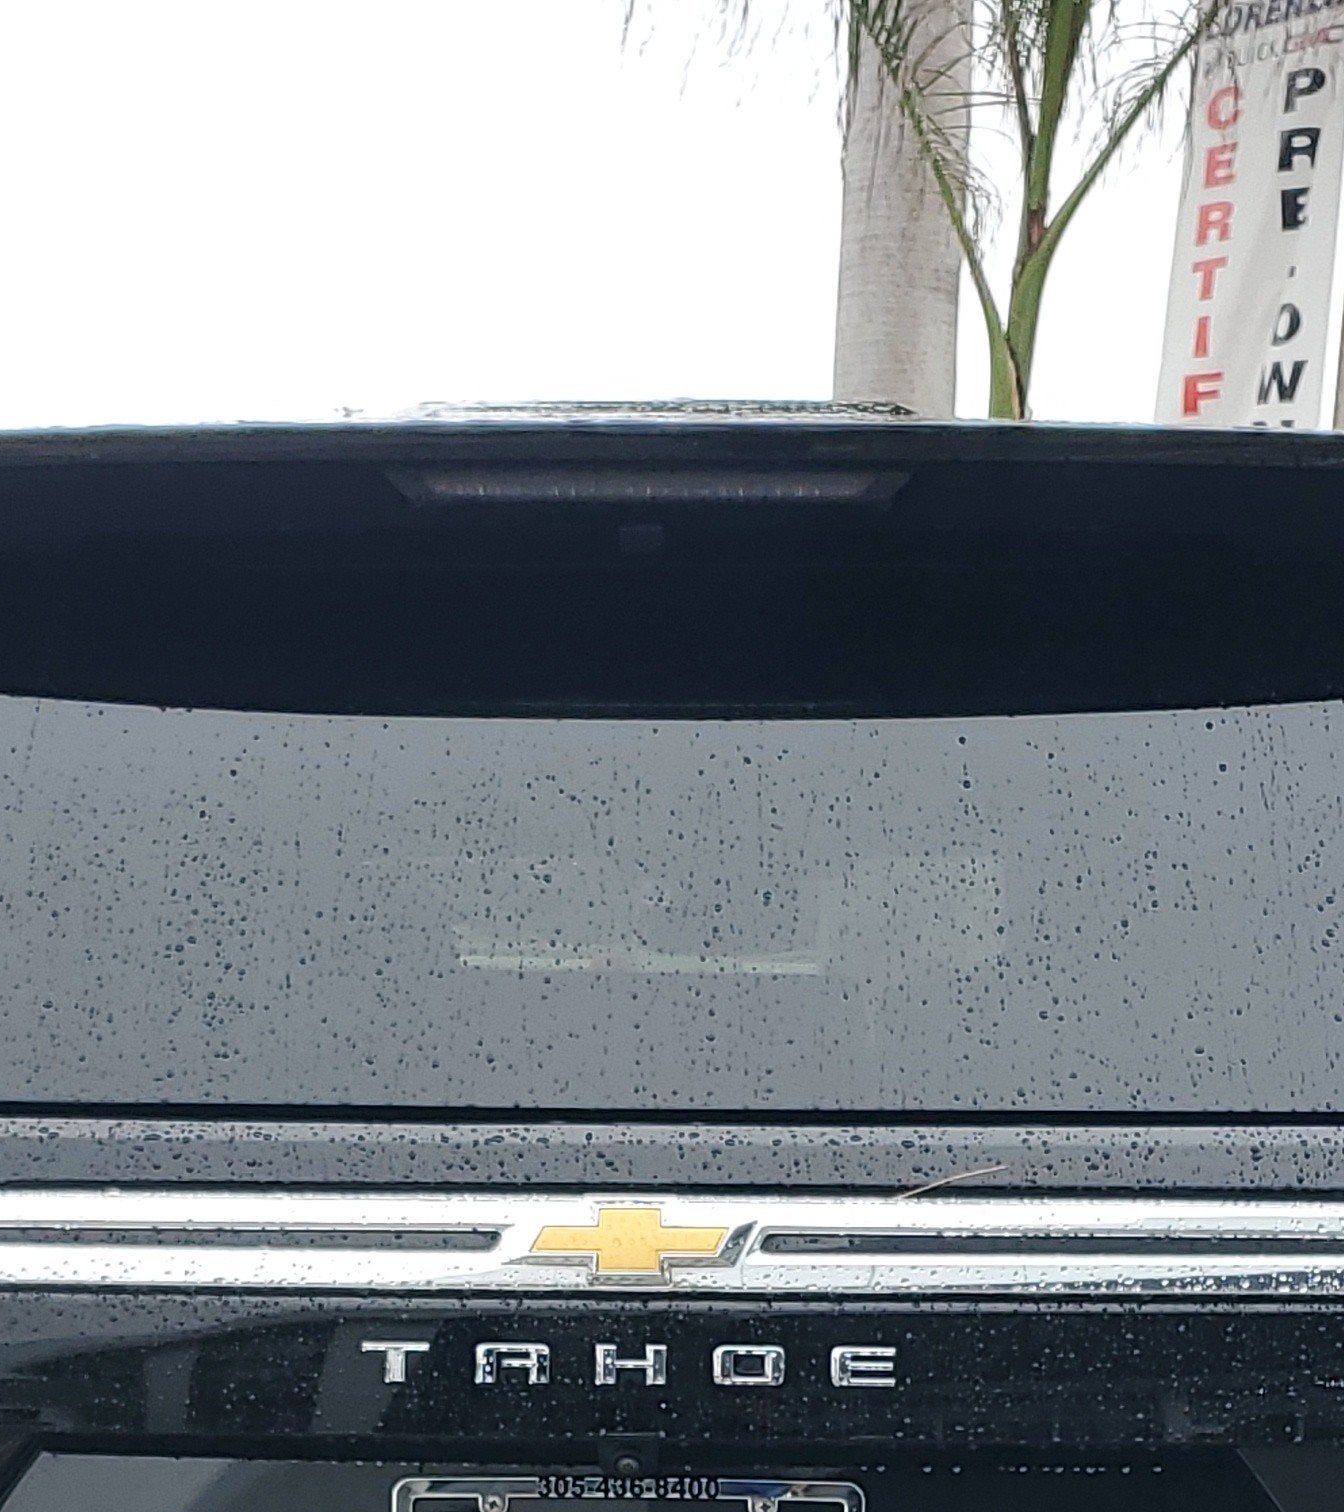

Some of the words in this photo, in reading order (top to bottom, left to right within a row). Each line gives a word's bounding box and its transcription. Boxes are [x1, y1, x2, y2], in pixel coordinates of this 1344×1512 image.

[1181, 86, 1242, 417] CERTIF
[361, 1340, 897, 1388] TAHOE
[536, 1476, 720, 1499] 305-436-8400
